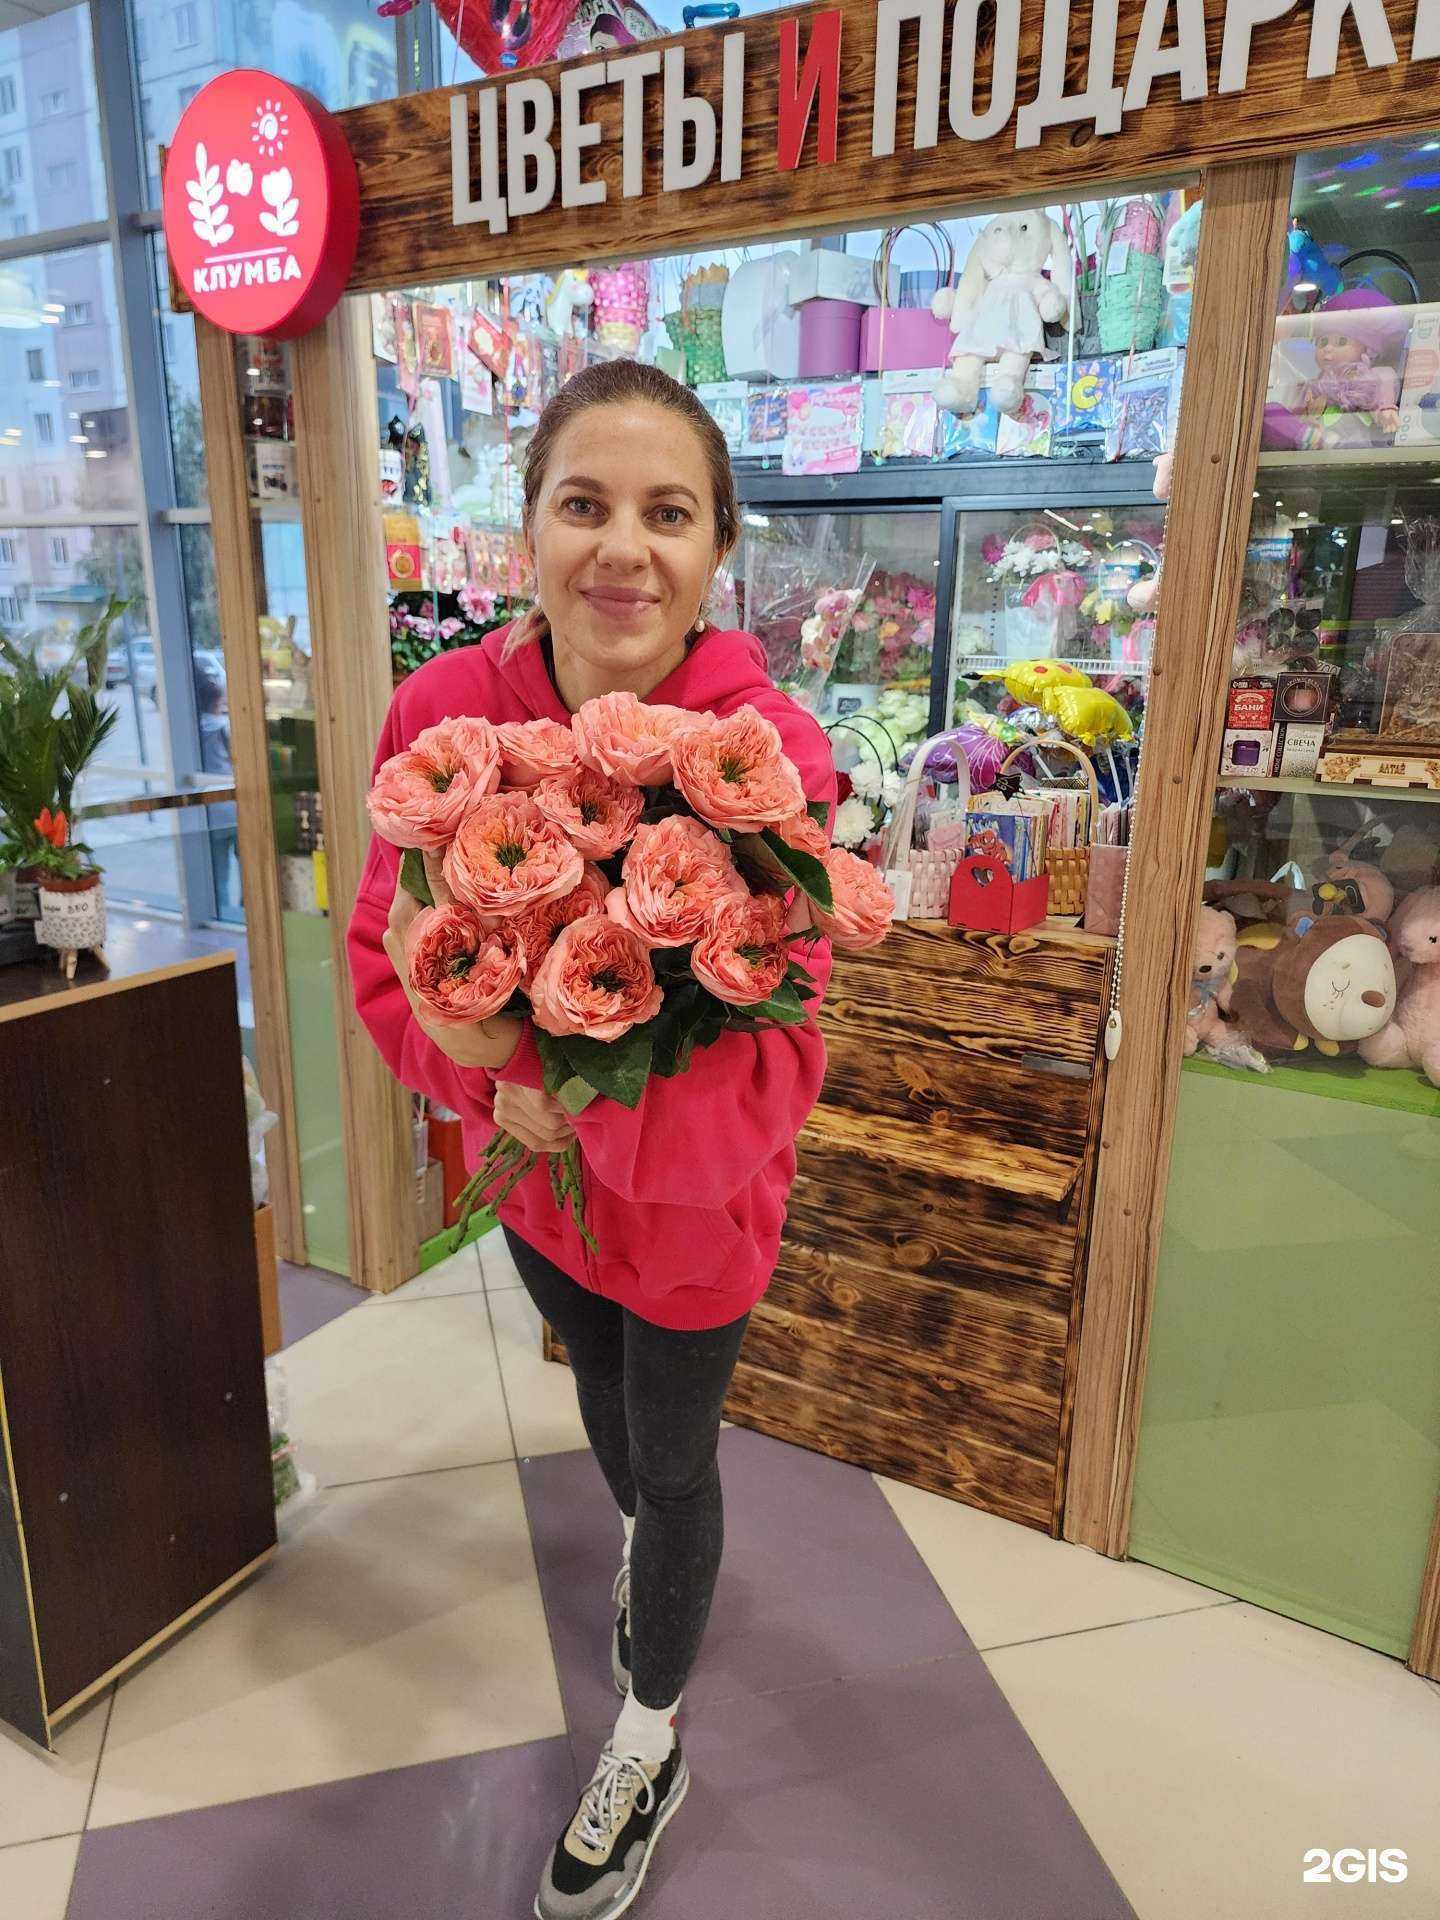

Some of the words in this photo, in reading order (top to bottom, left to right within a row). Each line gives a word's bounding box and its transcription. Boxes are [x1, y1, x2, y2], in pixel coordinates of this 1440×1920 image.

[450, 31, 746, 235] ЦВЕТЫ
[777, 9, 843, 170] И
[872, 0, 1440, 157] ПОДАРК
[193, 254, 302, 293] КЛУМБА
[1234, 703, 1264, 711] БАНИ
[1287, 738, 1316, 747] СВЕЧА
